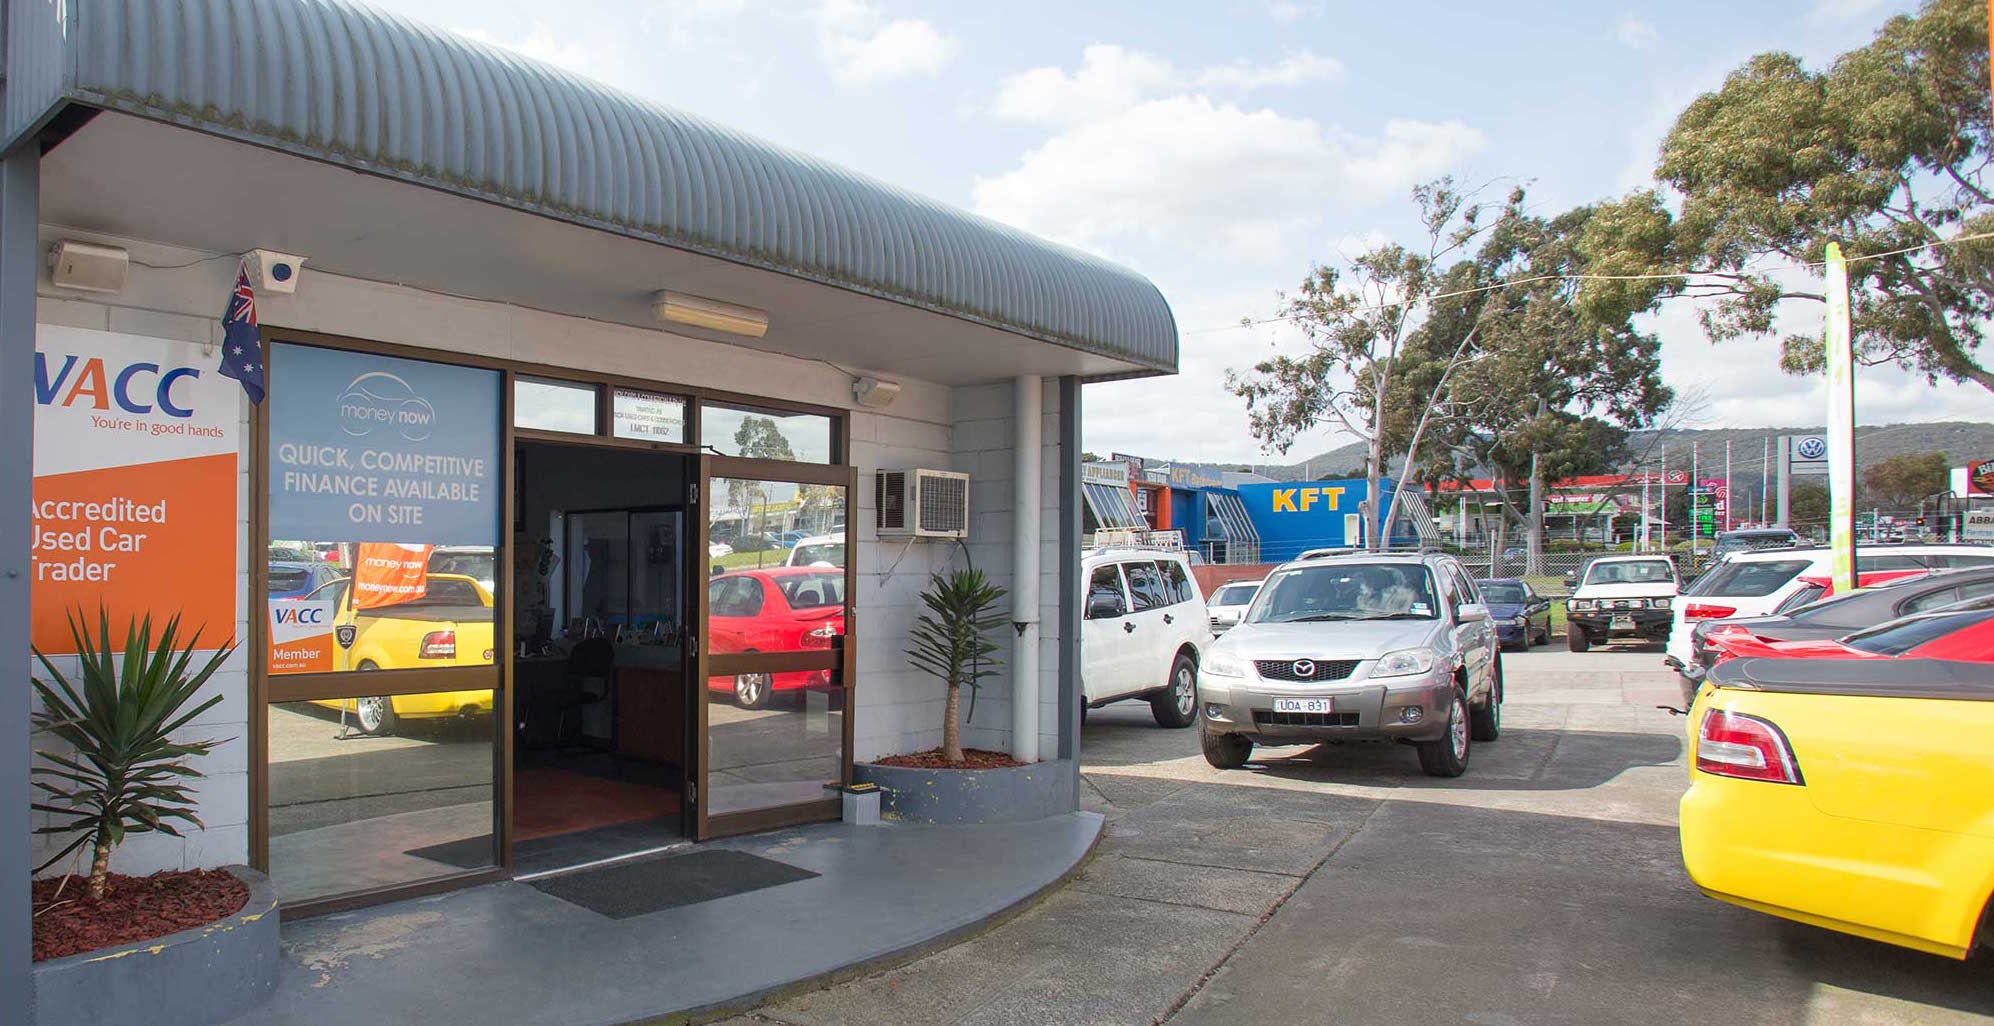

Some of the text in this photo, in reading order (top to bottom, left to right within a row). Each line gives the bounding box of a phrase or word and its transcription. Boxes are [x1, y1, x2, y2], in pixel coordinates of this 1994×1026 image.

[34, 351, 200, 418] VACC
[341, 404, 432, 425] money now
[91, 415, 225, 439] You're in good hands
[279, 443, 484, 478] QUICK, COMPETITIVE
[284, 471, 479, 502] FINANCE AVAILABLE
[1171, 468, 1190, 484] KFT
[1273, 487, 1345, 512] KFT
[348, 503, 423, 525] ON SITE
[99, 526, 147, 552] Car
[32, 556, 116, 582] rader
[365, 557, 401, 569] money
[276, 608, 323, 624] VACC
[274, 649, 320, 660] Member
